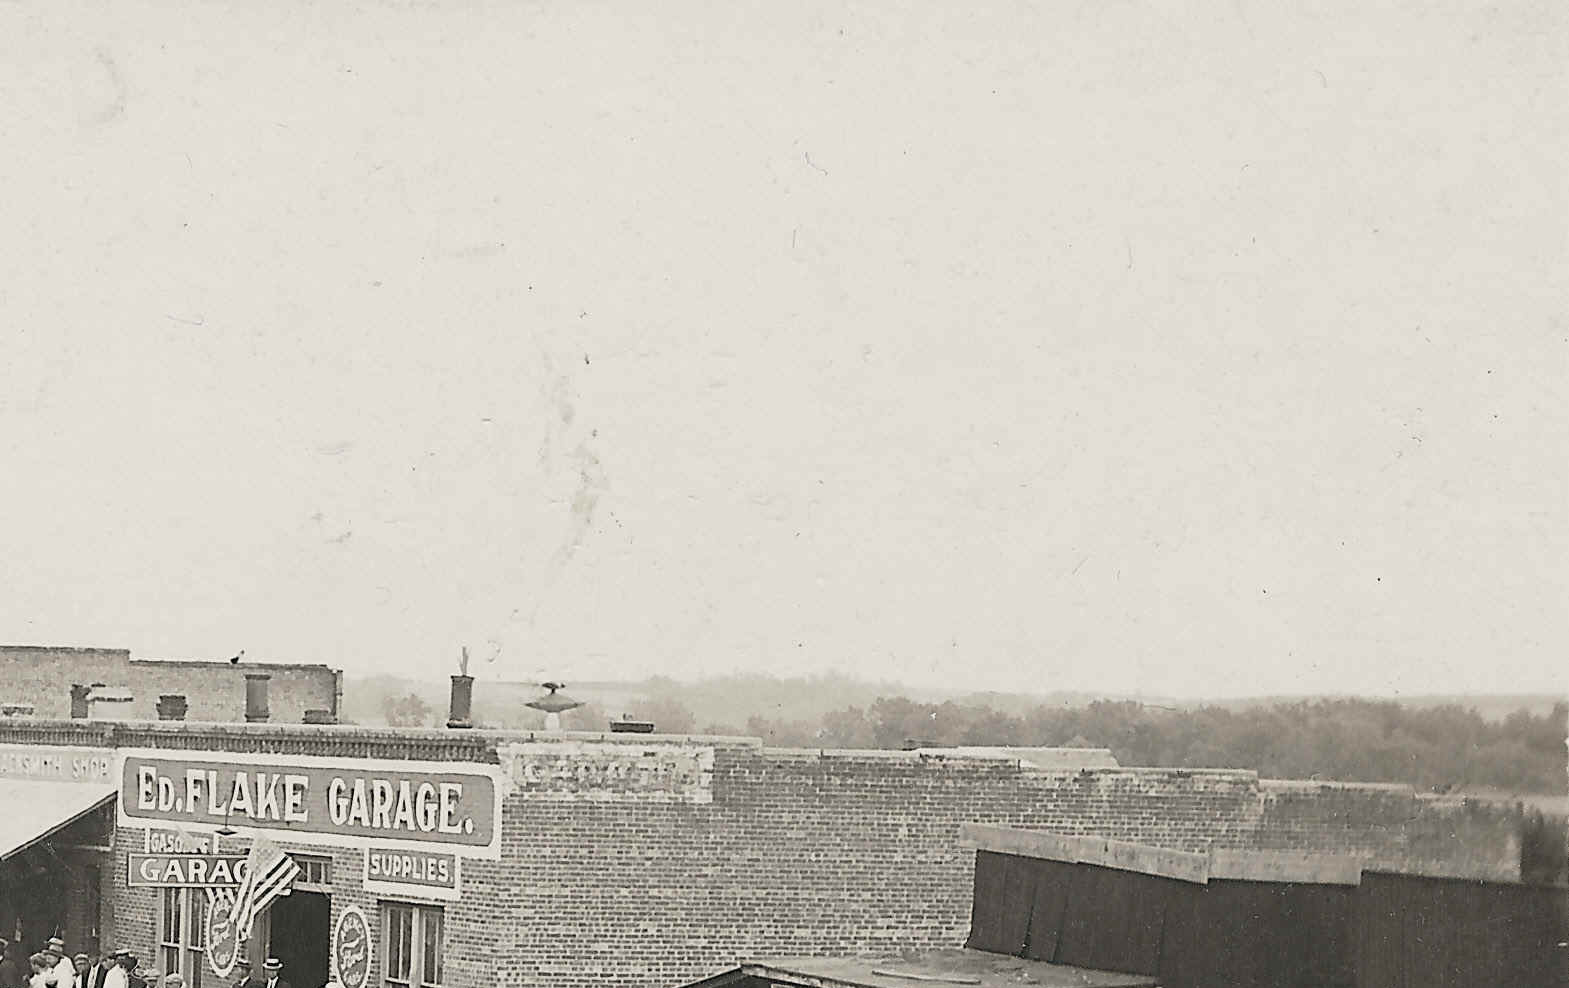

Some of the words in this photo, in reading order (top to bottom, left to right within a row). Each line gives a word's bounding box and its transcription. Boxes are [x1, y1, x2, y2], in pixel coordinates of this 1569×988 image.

[185, 769, 310, 823] FLAKE
[328, 776, 475, 835] GARAGE.
[139, 857, 248, 881] GARAG
